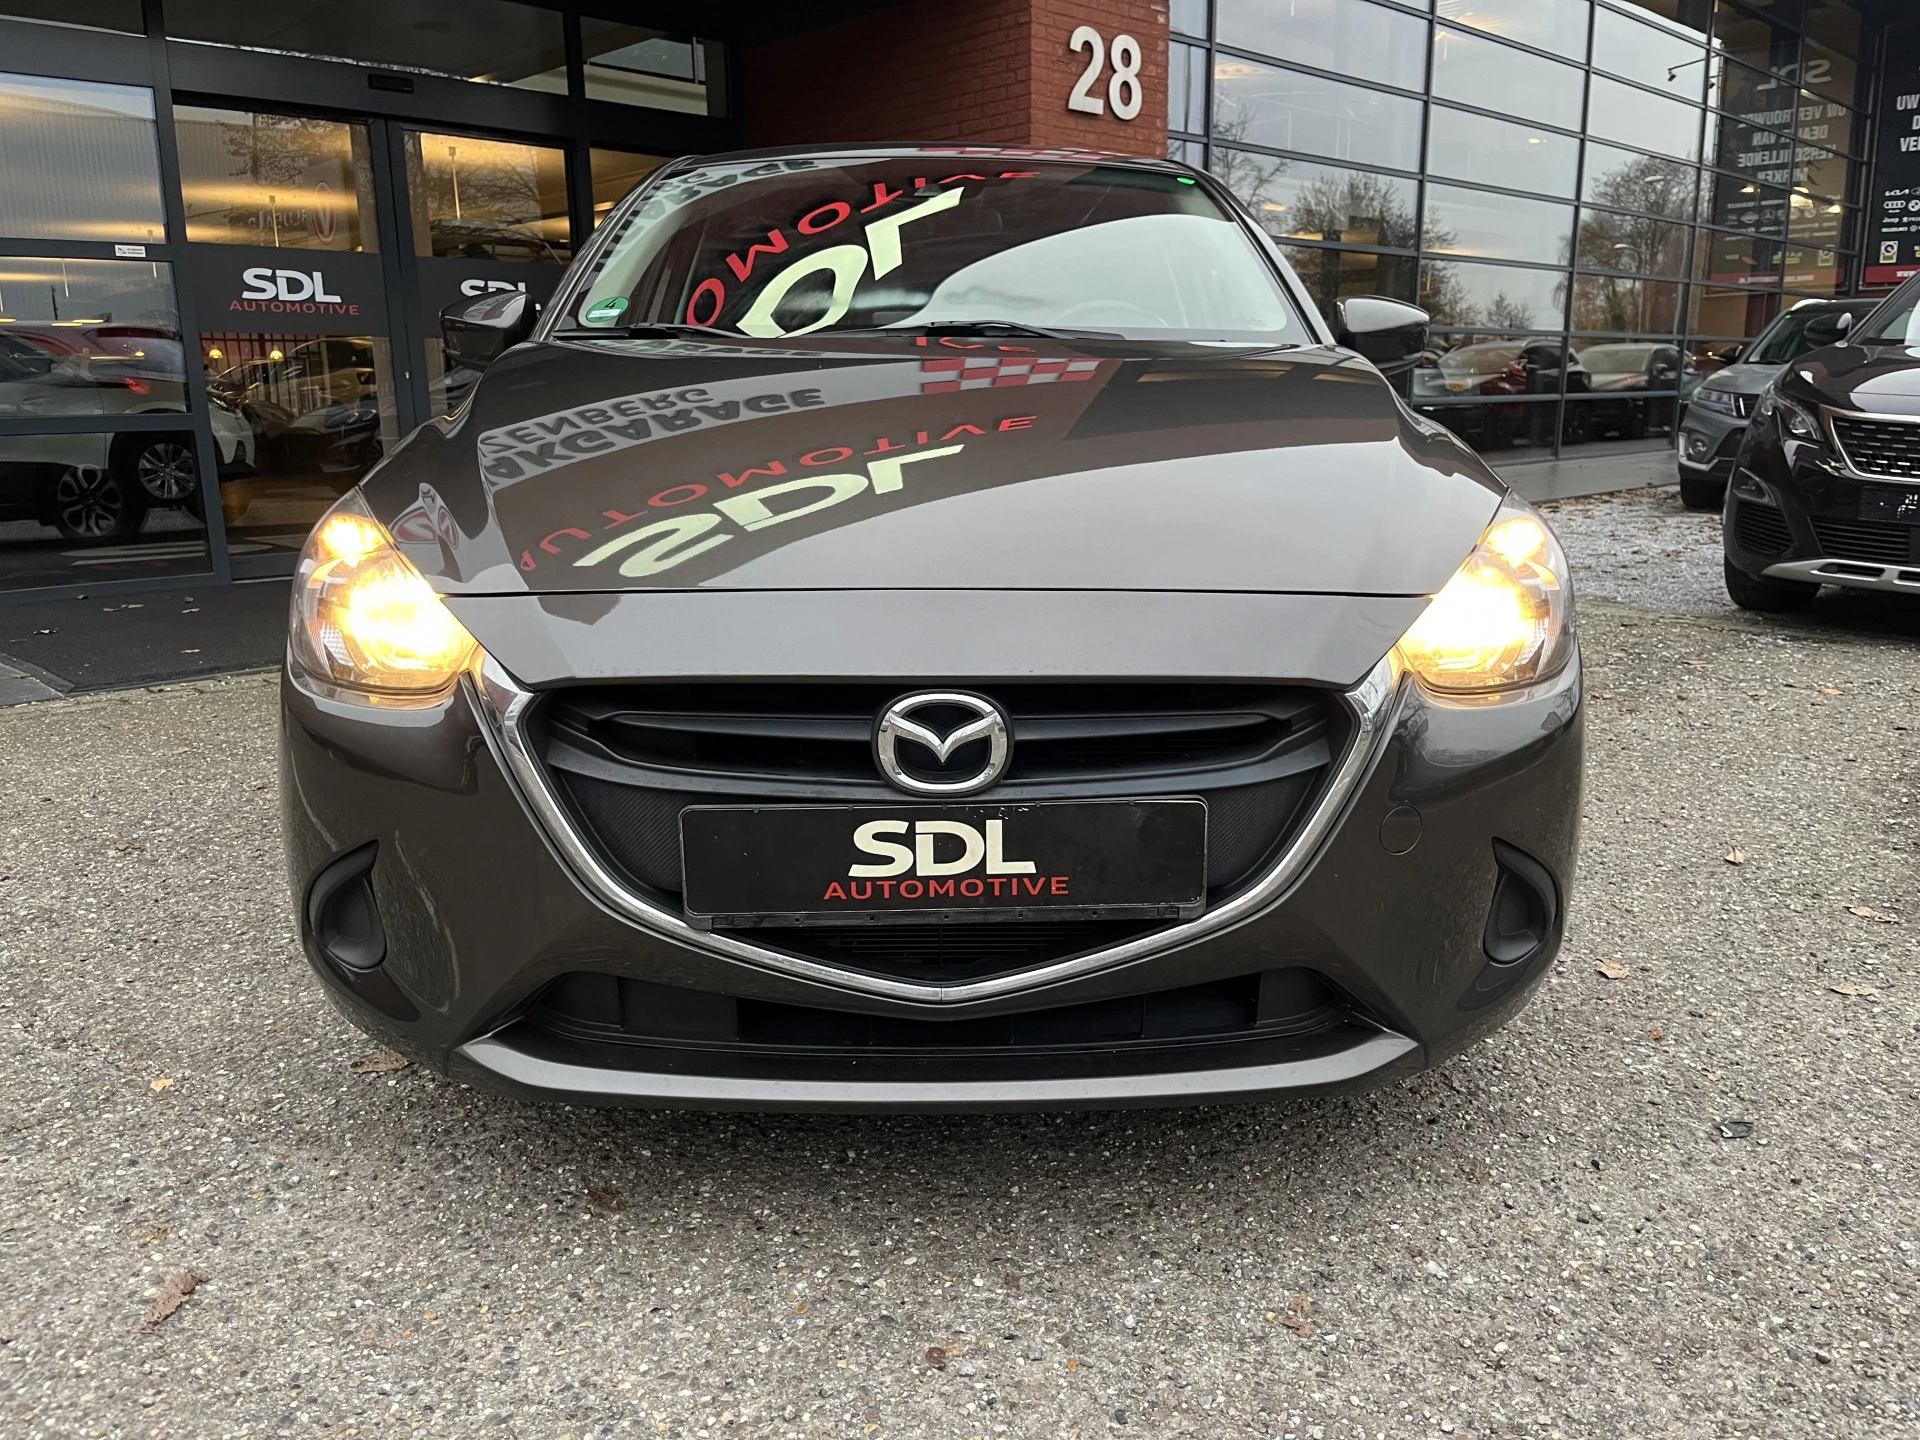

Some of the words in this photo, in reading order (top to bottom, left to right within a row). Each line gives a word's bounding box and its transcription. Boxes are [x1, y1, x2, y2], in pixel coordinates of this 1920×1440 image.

[1067, 25, 1142, 121] 28
[1896, 93, 1920, 111] UW
[1899, 136, 1920, 152] VE
[241, 266, 342, 303] SDL
[229, 299, 360, 316] AUTOMOTIVE
[848, 819, 1037, 877] SDL
[823, 876, 1070, 900] AUTOMOTIVE
